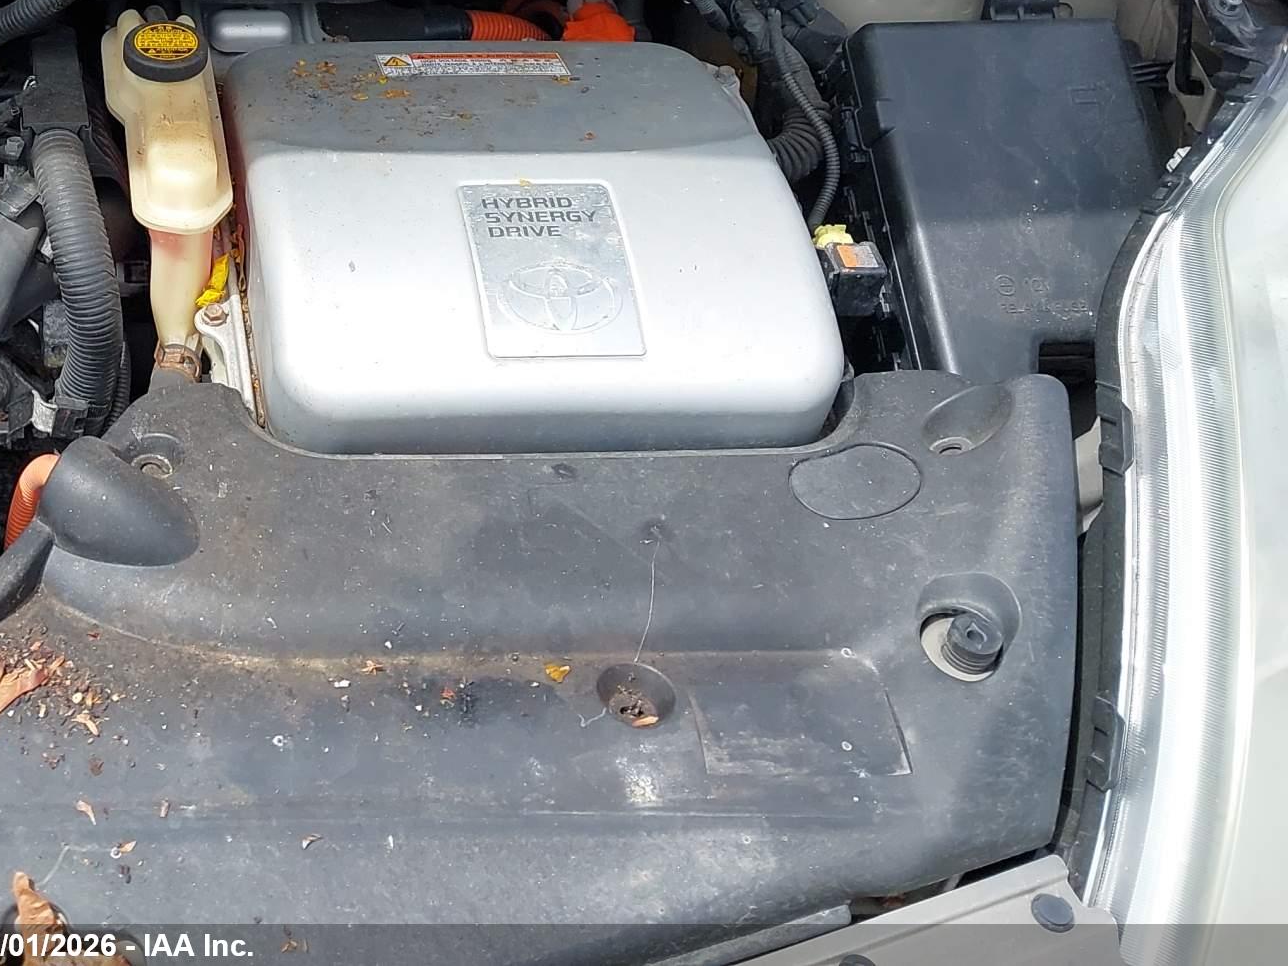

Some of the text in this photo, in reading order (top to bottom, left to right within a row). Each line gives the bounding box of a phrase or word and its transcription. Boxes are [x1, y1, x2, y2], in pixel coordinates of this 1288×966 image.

[481, 196, 573, 209] HYBRID
[485, 210, 597, 224] SYNERGY
[488, 225, 562, 238] DRIVE
